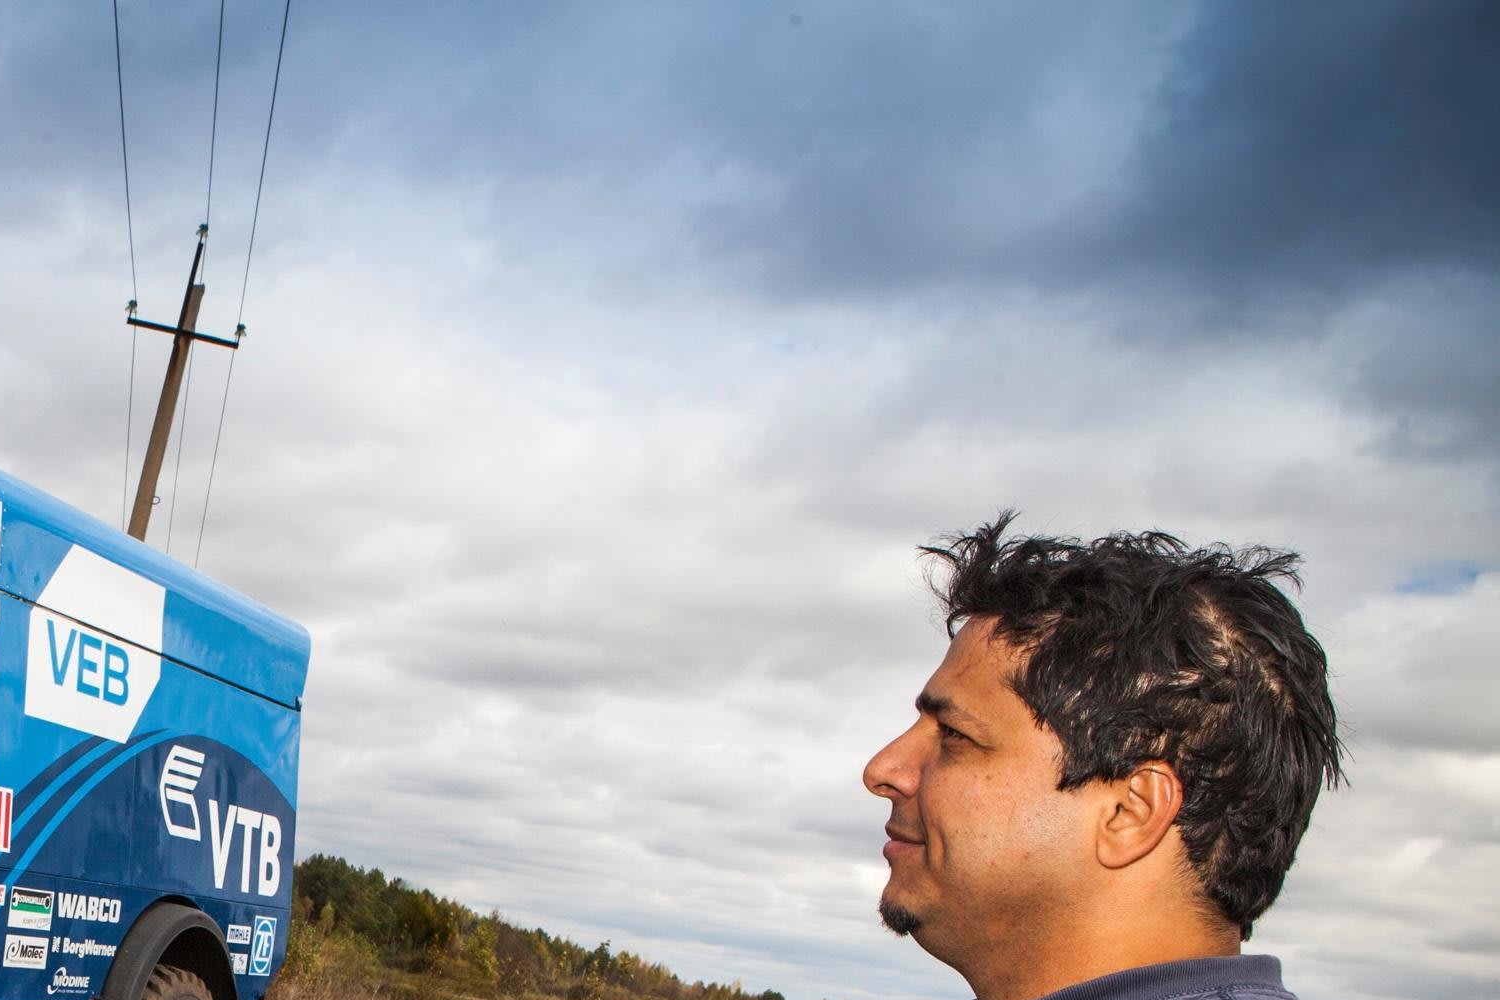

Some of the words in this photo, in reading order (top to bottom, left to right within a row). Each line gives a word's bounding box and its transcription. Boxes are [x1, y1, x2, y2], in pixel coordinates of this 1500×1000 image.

[46, 618, 130, 706] VEB
[208, 799, 282, 897] VTB
[58, 892, 121, 924] WABCO
[62, 937, 117, 958] BorgWarner
[53, 975, 90, 988] MODINE
